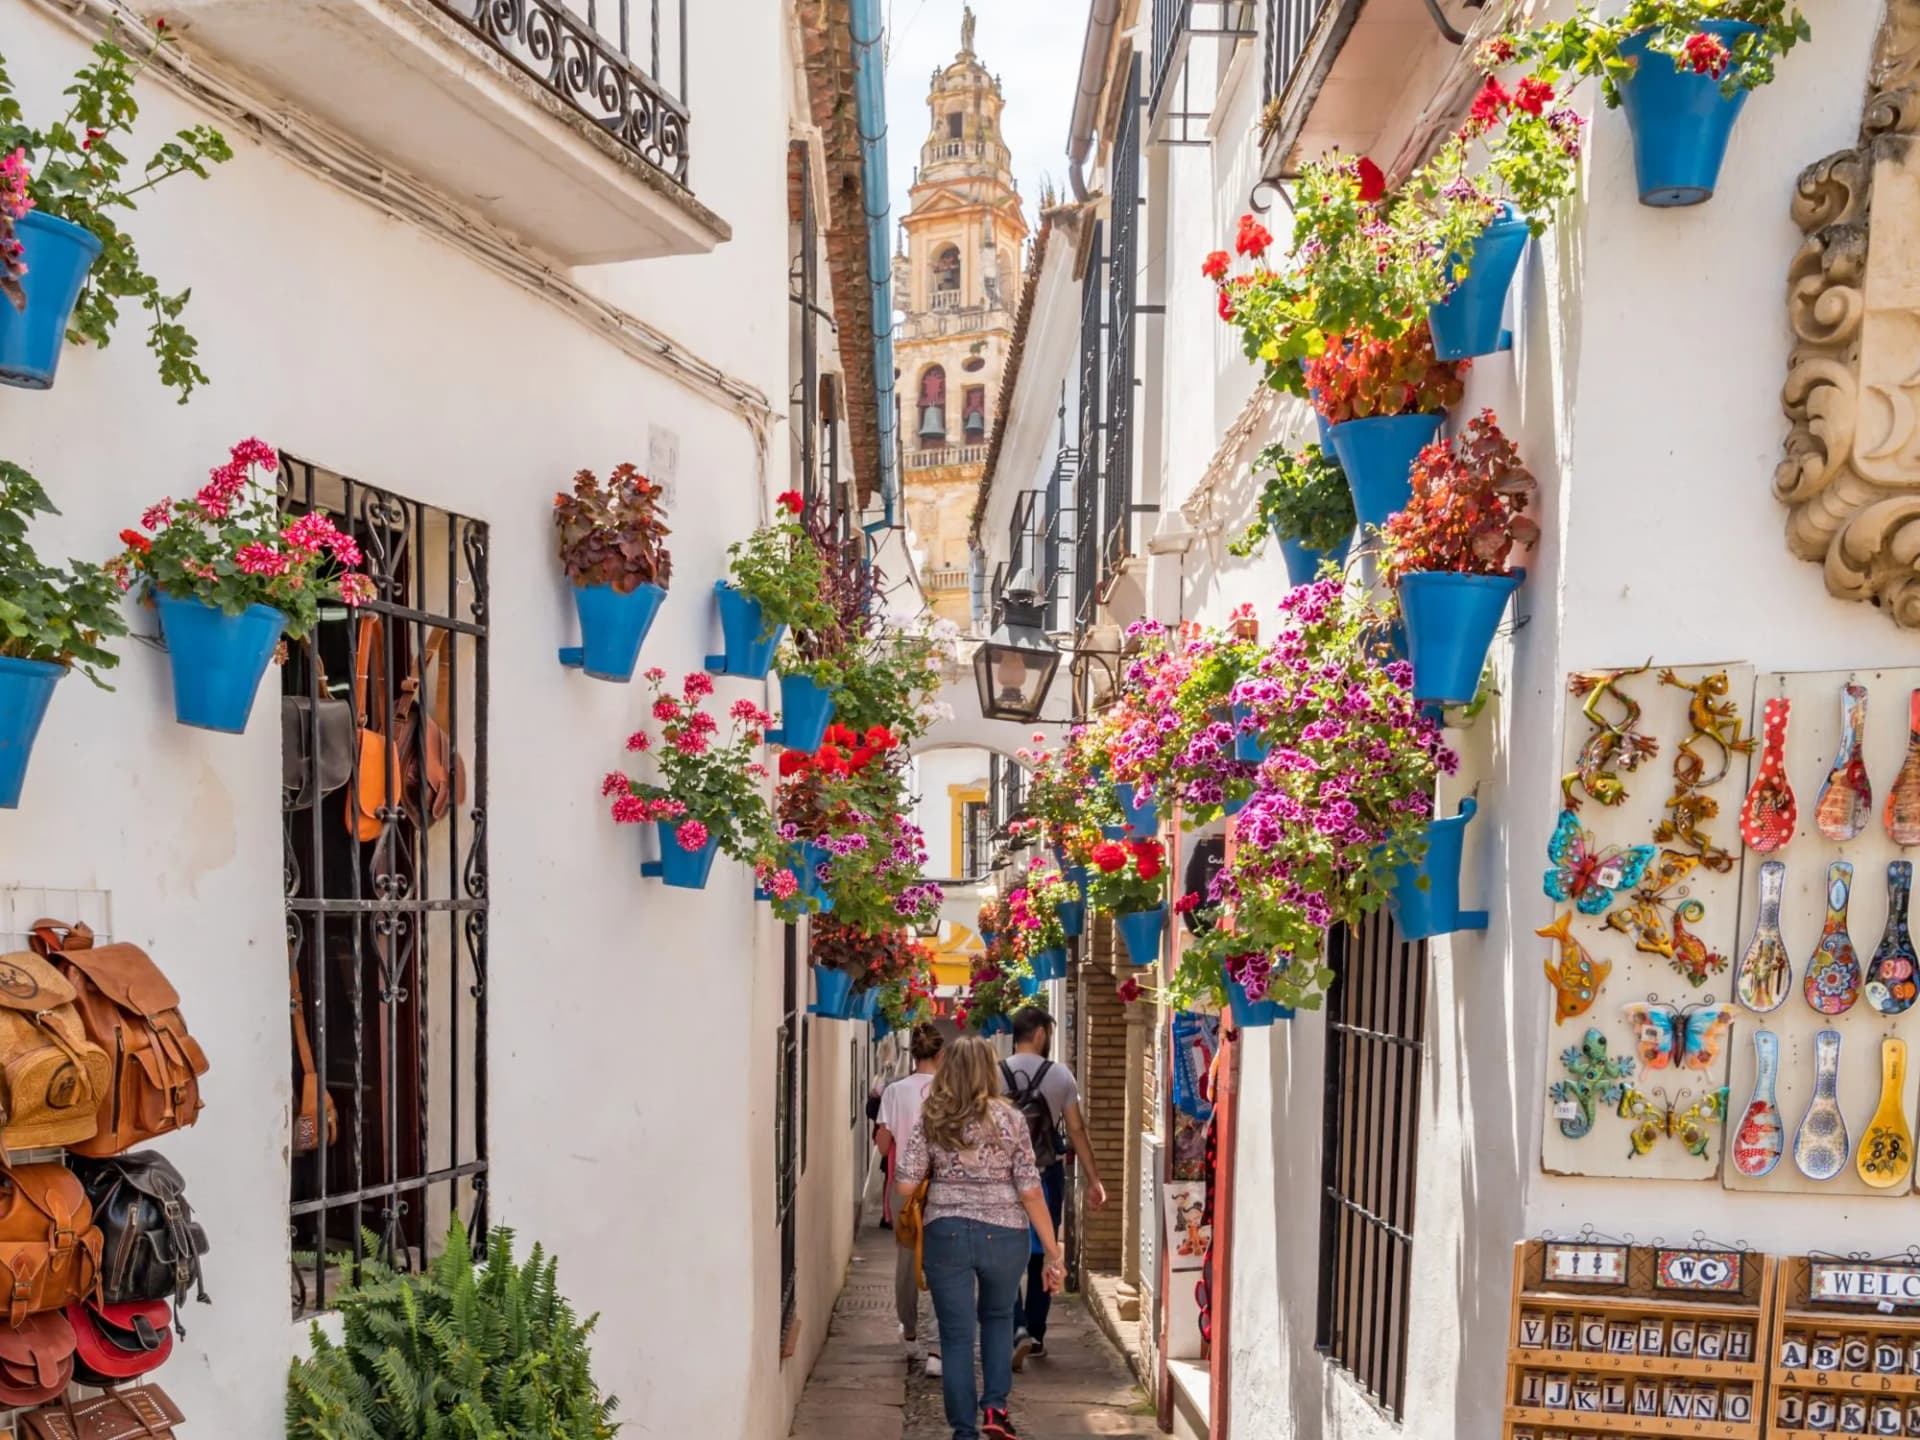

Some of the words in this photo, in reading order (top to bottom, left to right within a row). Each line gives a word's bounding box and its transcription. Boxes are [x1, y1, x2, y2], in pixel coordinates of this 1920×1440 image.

[1680, 1261, 1717, 1281] WC
[1833, 1272, 1920, 1297] WELC
[1556, 1324, 1571, 1344] B
[1586, 1324, 1603, 1345] C
[1642, 1329, 1660, 1350] E
[1673, 1330, 1692, 1351] G
[1700, 1334, 1718, 1355] G
[1729, 1333, 1748, 1355] H
[1784, 1344, 1801, 1363] A
[1817, 1348, 1834, 1366] B
[1846, 1345, 1865, 1363] C
[1878, 1348, 1896, 1367] D
[1784, 1371, 1797, 1383] A
[1816, 1373, 1828, 1385] B
[1851, 1374, 1862, 1387] C
[1881, 1377, 1891, 1390] D
[1528, 1377, 1539, 1400] I
[1549, 1383, 1565, 1404] J
[1576, 1391, 1594, 1409] K
[1606, 1386, 1623, 1405] L
[1636, 1389, 1656, 1411] M
[1667, 1395, 1690, 1415] N
[1731, 1396, 1750, 1418] O
[1786, 1400, 1797, 1419] I
[1810, 1405, 1827, 1423] J
[1844, 1407, 1861, 1427] K
[1880, 1410, 1897, 1430] L
